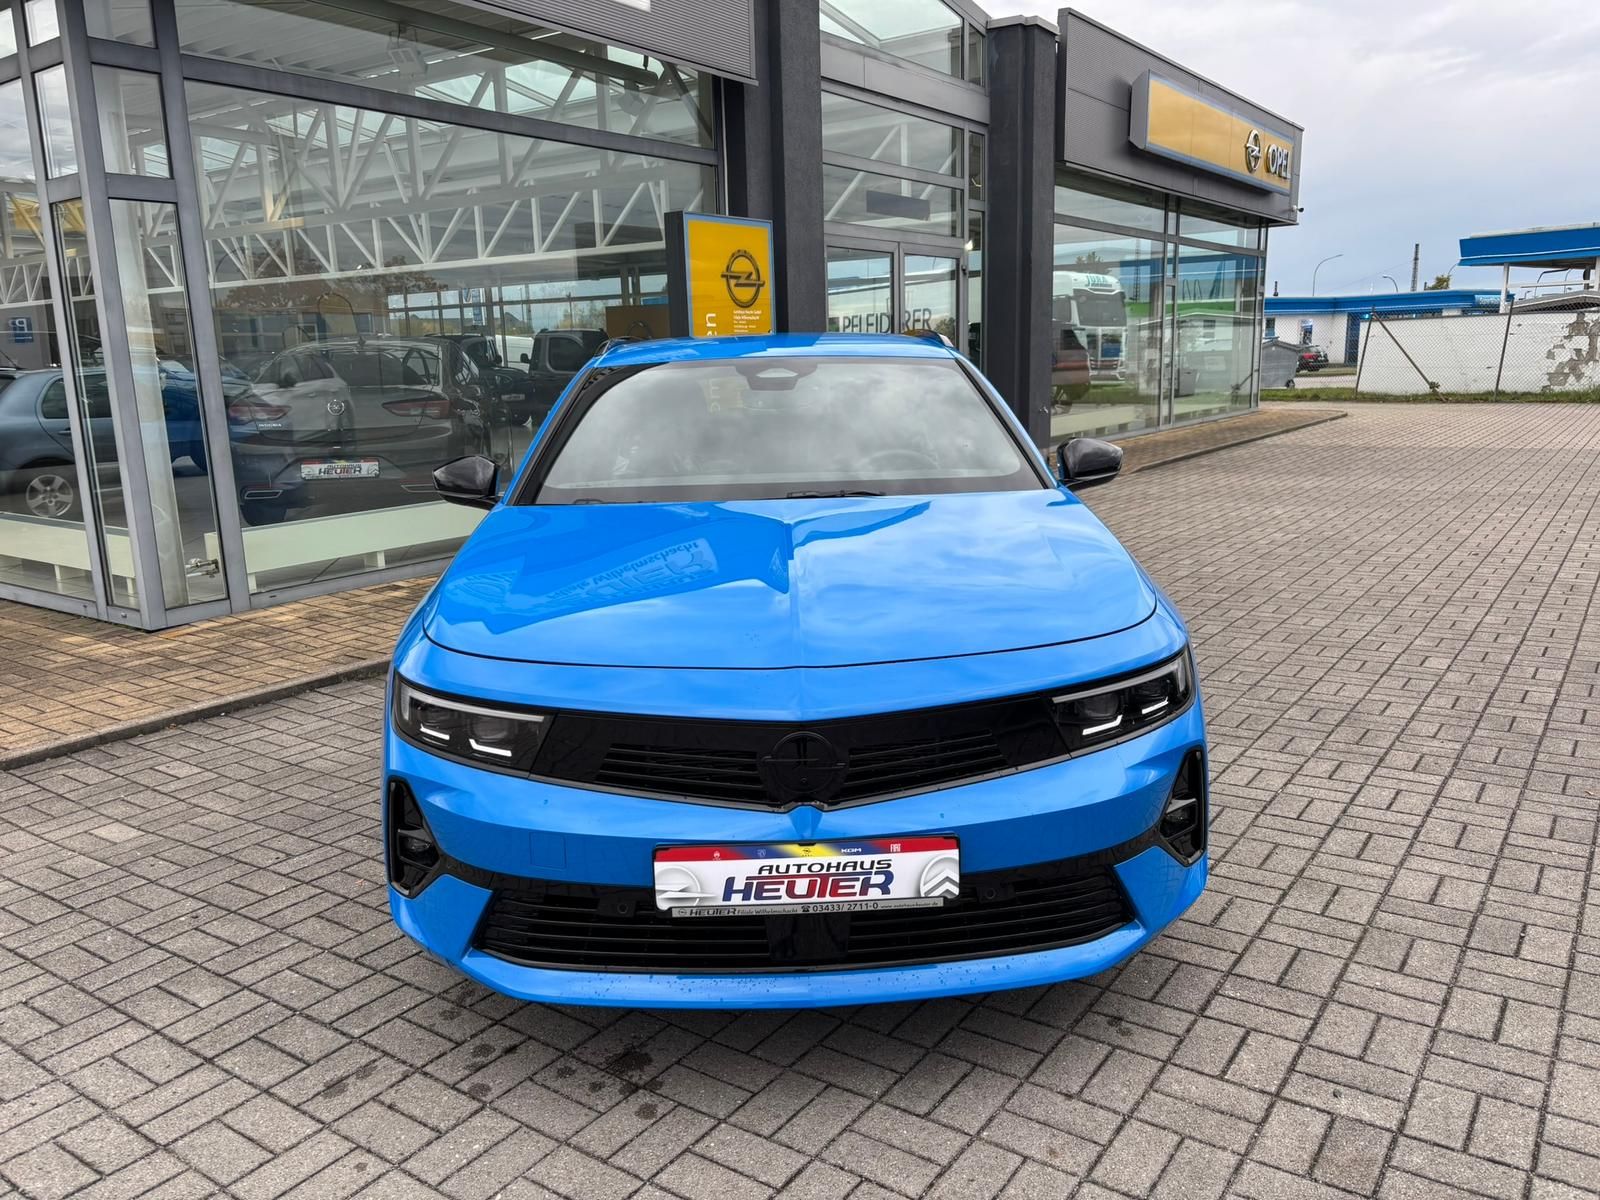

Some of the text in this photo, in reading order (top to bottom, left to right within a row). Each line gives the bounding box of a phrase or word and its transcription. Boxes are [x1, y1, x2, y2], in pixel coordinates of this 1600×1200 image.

[1267, 144, 1291, 179] OPEL
[842, 308, 932, 334] PFLEIDRER
[890, 843, 902, 853] FIAT
[758, 859, 892, 875] AUTOHAUS
[722, 870, 895, 902] HEUTER
[689, 908, 737, 917] HEUTER
[812, 903, 845, 913] 03433/
[847, 902, 879, 911] 2711-0
